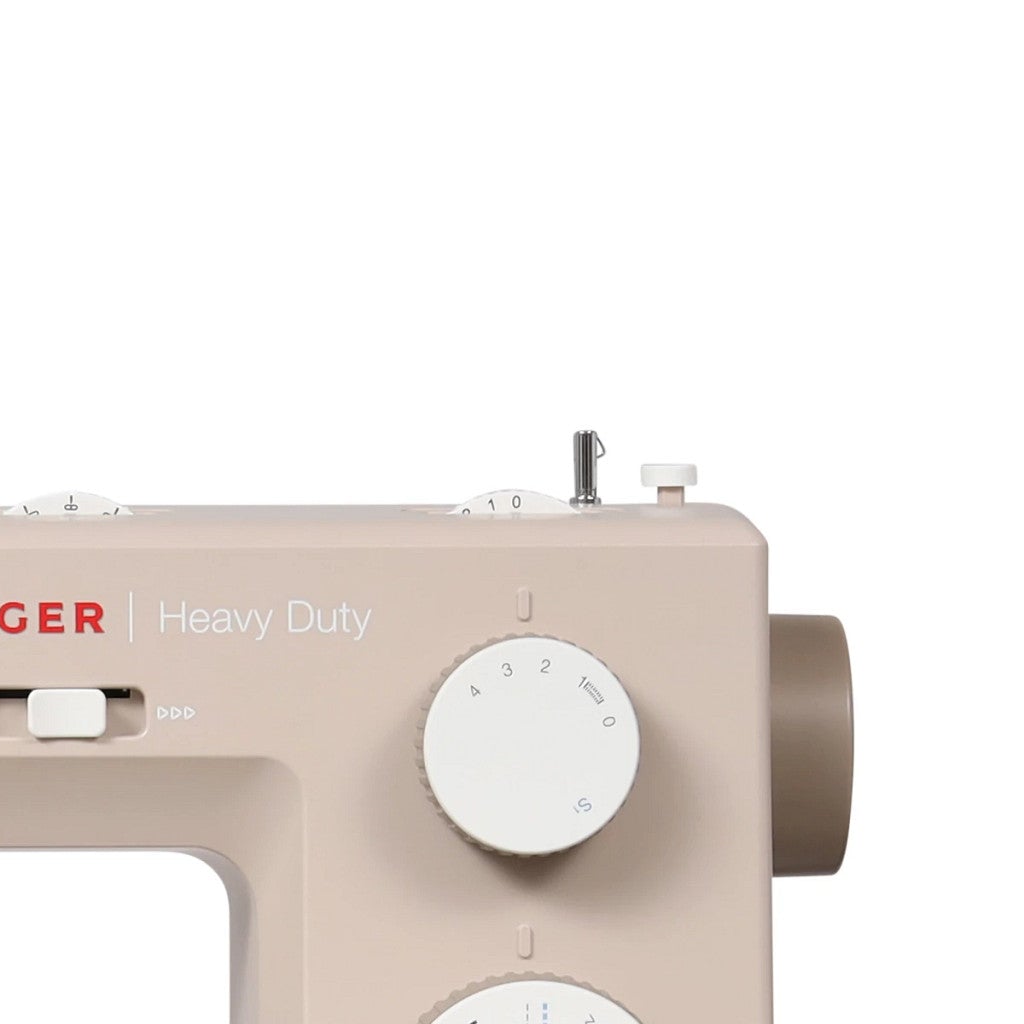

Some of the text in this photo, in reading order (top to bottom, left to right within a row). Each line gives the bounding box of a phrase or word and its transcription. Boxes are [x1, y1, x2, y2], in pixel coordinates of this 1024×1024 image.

[488, 495, 522, 511] 1 0
[159, 599, 274, 641] Heavy
[287, 599, 372, 641] Duty
[470, 684, 481, 697] 4
[501, 662, 513, 677] 3
[540, 658, 551, 674] 2
[602, 716, 616, 727] 0
